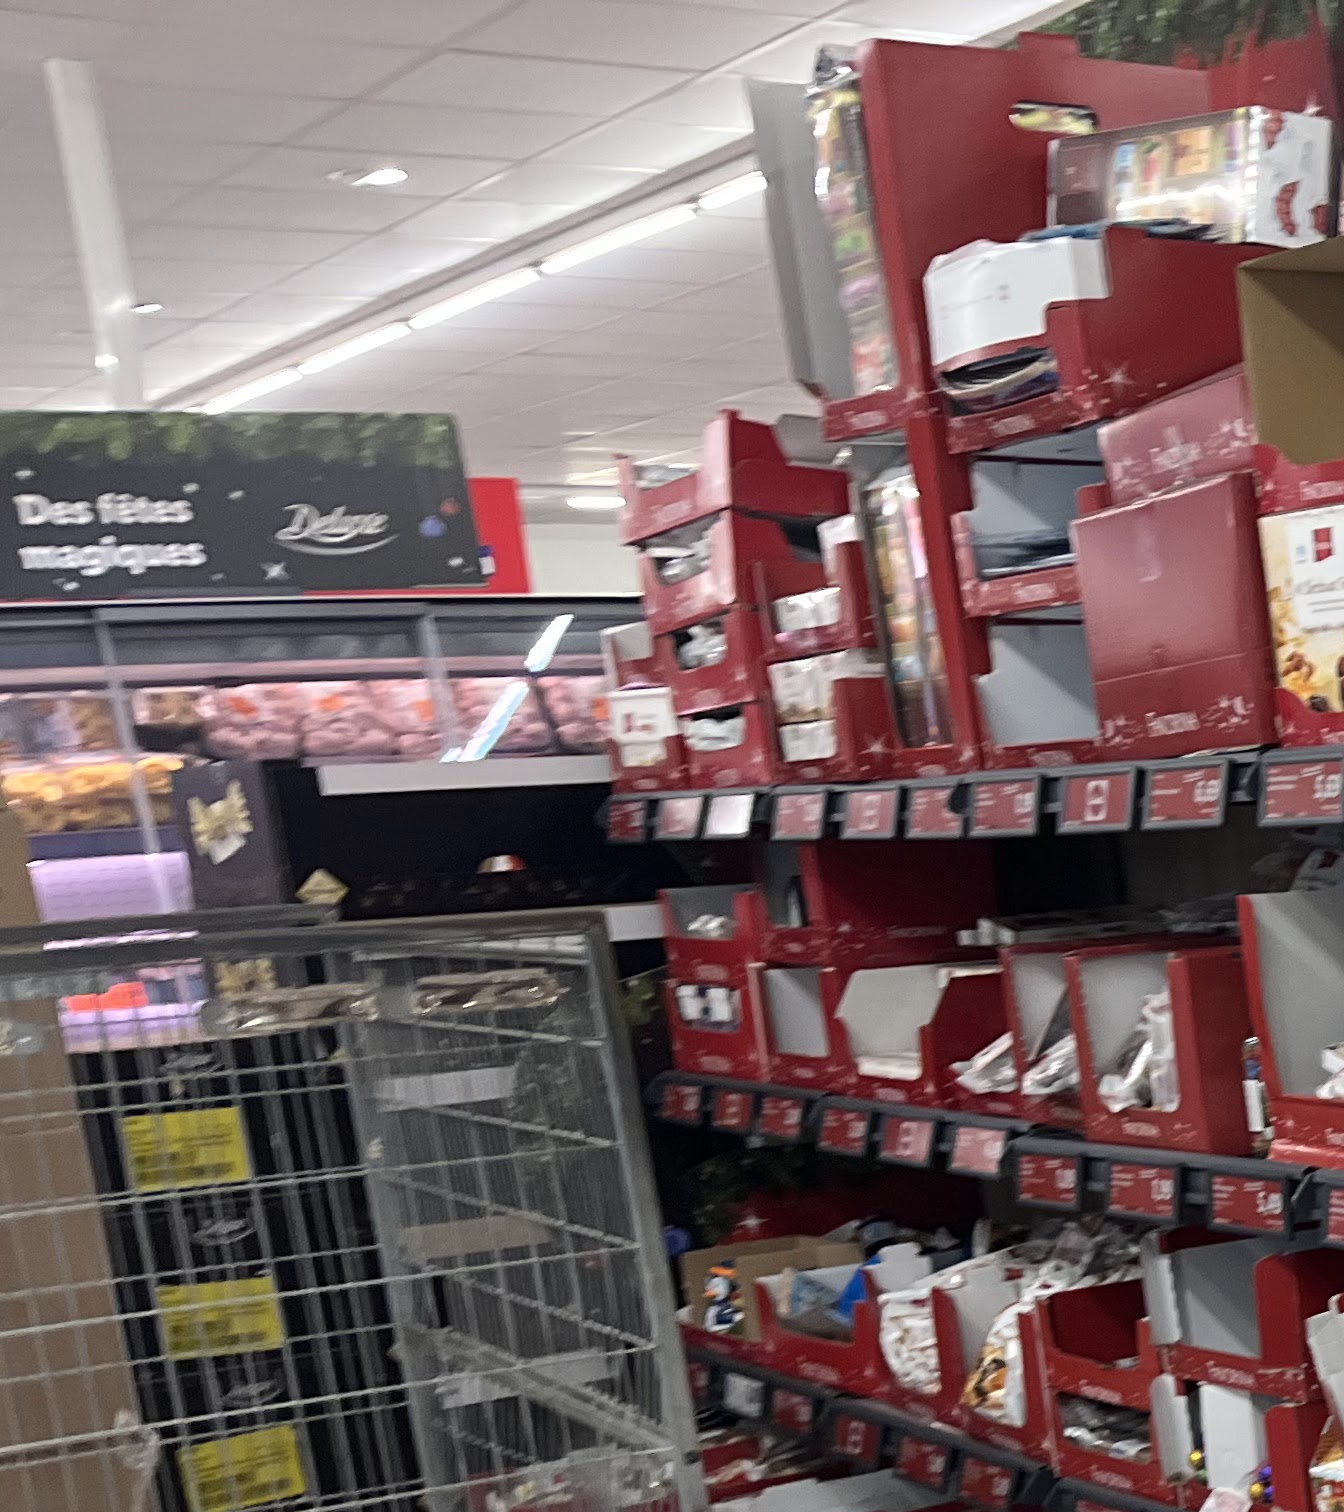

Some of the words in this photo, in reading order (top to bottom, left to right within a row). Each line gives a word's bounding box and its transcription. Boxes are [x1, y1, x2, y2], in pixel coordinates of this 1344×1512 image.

[12, 493, 95, 526] Des
[97, 491, 194, 525] fêtes
[18, 534, 208, 577] magiques
